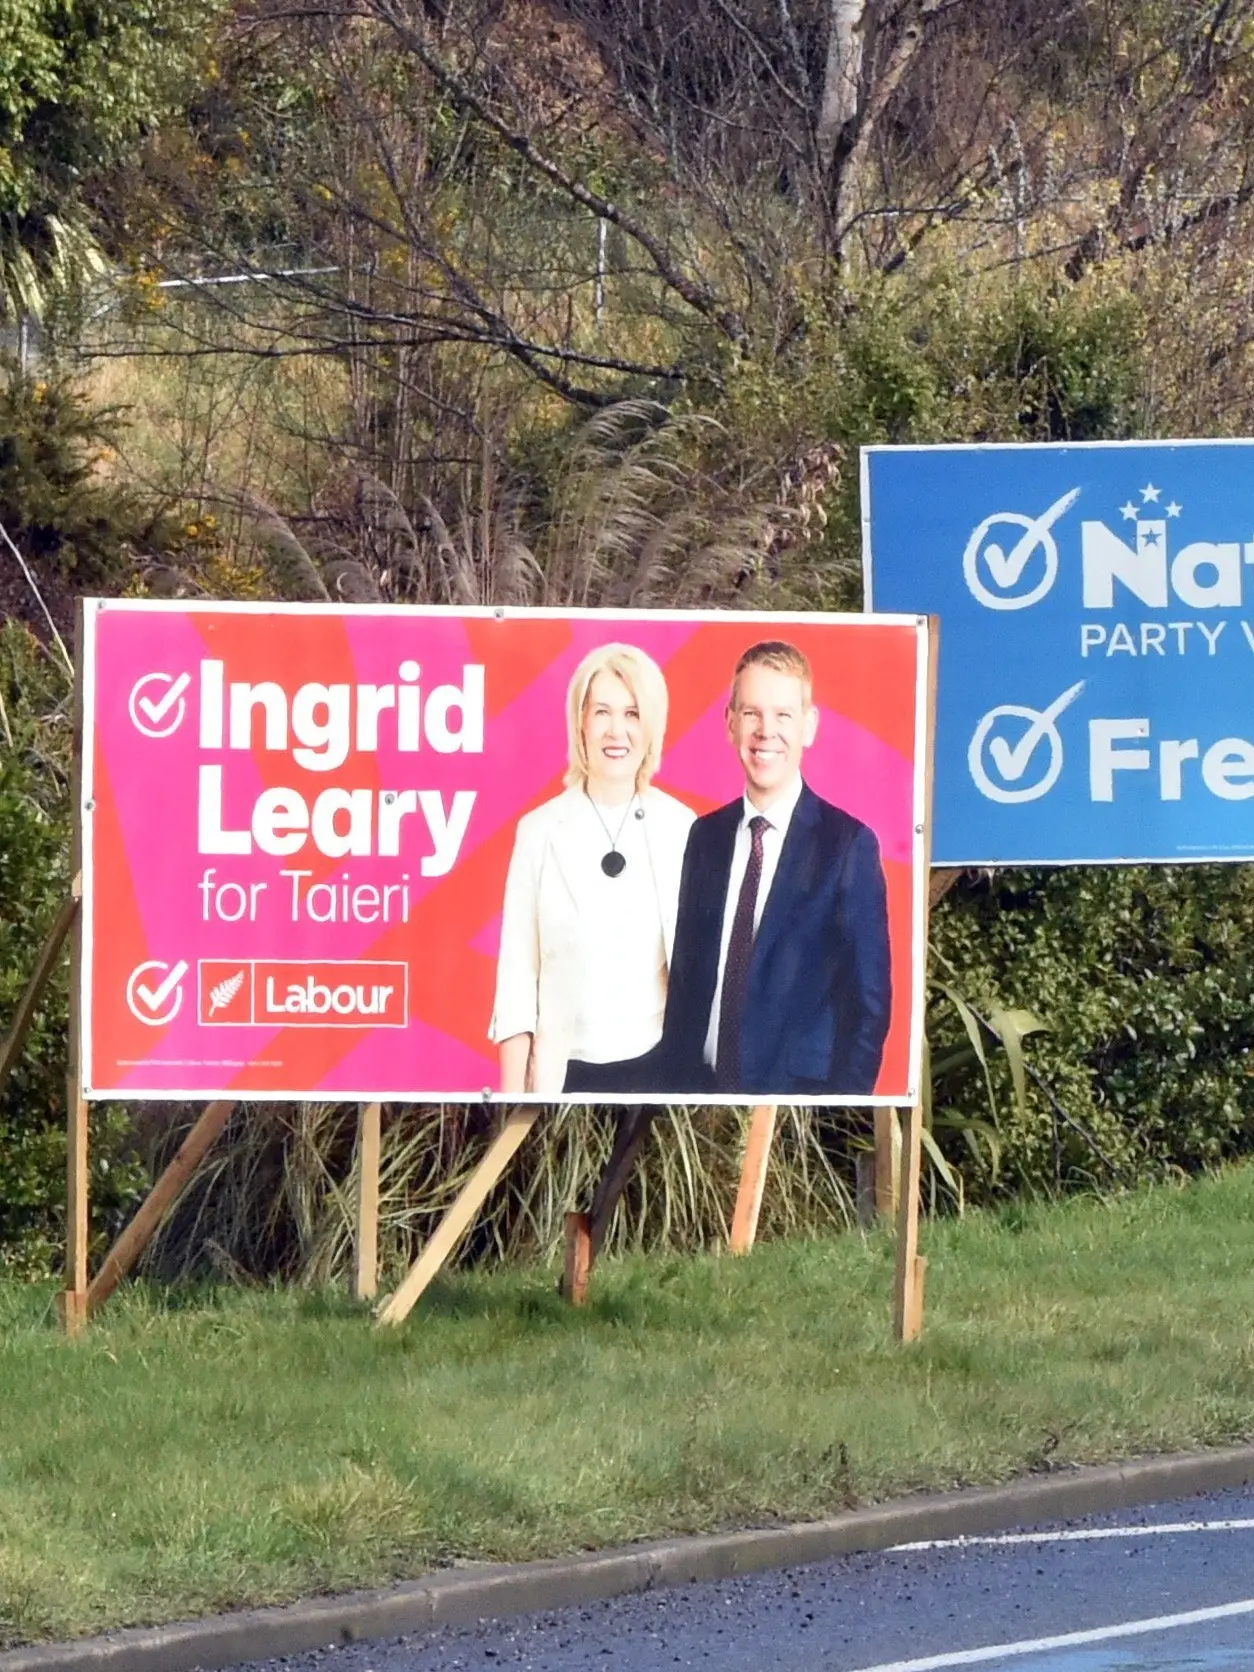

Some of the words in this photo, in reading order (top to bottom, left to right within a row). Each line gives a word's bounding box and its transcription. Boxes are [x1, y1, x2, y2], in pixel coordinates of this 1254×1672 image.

[1081, 621, 1226, 657] PARTY
[199, 659, 485, 772] Ingrid
[197, 764, 478, 878] Leary
[198, 868, 267, 922] for
[279, 869, 410, 924] Taieri
[266, 976, 394, 1015] Labour
